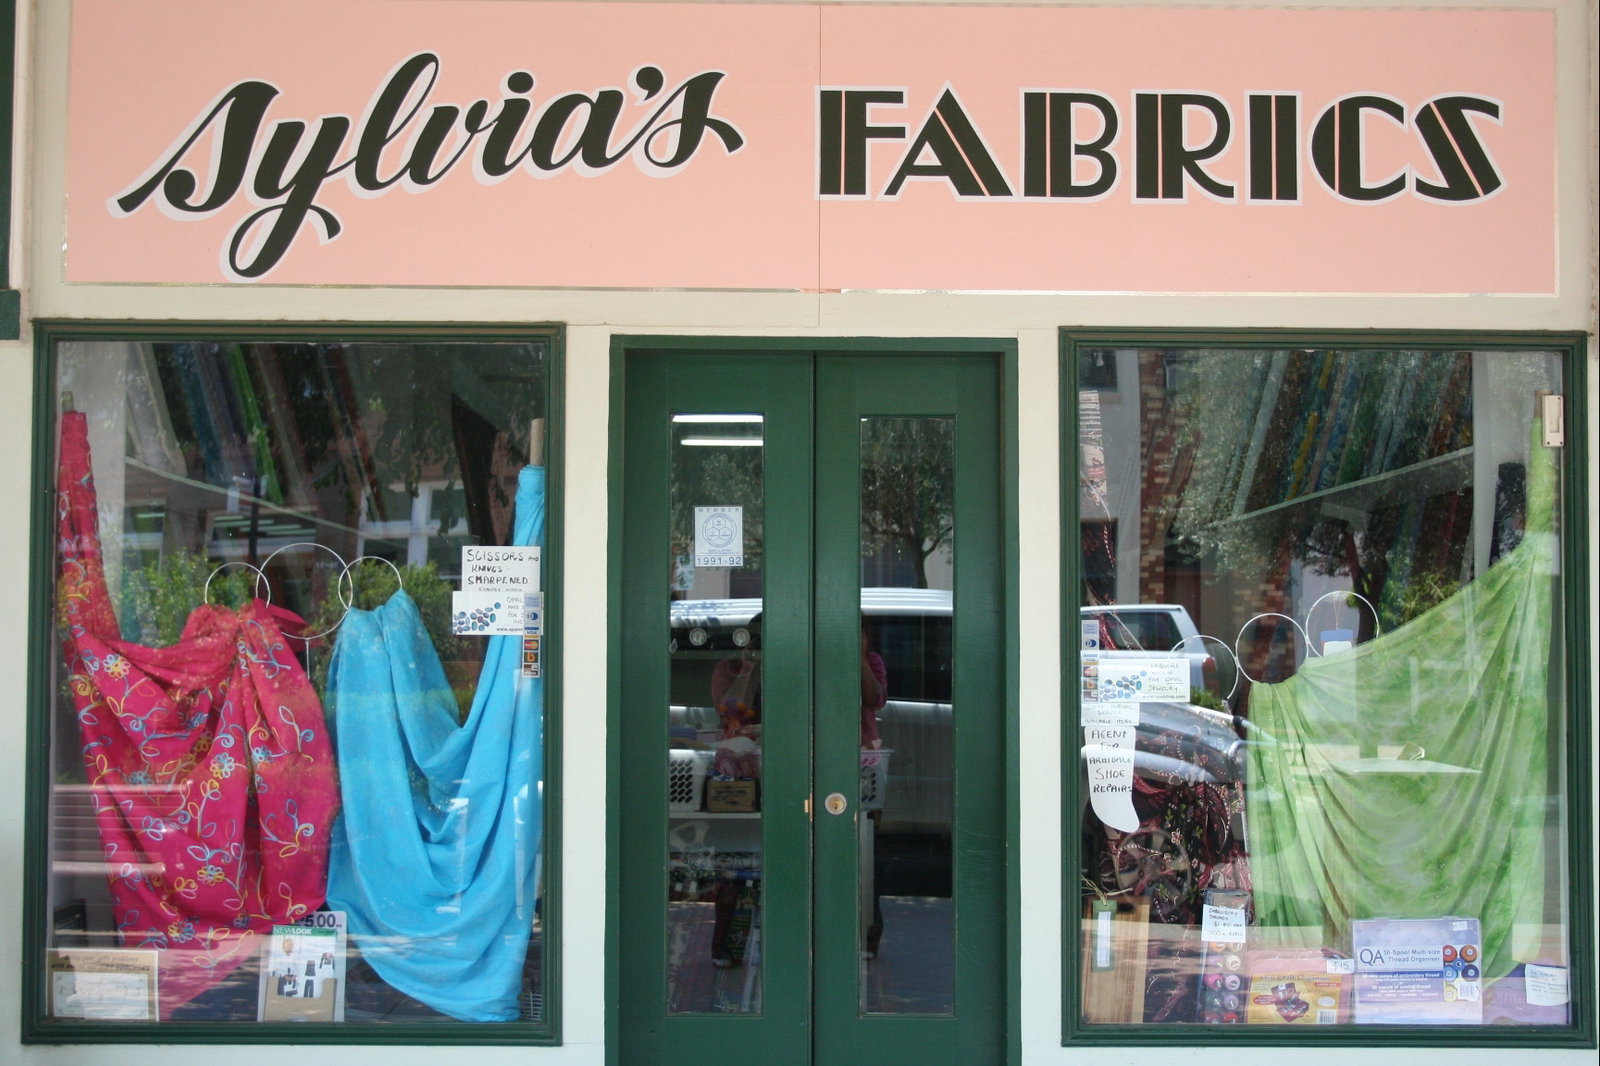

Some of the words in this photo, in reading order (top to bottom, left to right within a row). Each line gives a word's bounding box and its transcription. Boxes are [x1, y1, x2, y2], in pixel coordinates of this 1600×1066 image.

[113, 51, 745, 279] Sylvia's
[818, 83, 1506, 202] FABRICS
[466, 549, 524, 562] SCISSORS
[697, 556, 742, 566] 1991-92
[471, 564, 503, 573] KNIVES
[467, 575, 529, 585] SHARPENED
[1091, 729, 1128, 739] AGENT
[1094, 768, 1127, 781] SHOE
[1360, 948, 1385, 966] QA
